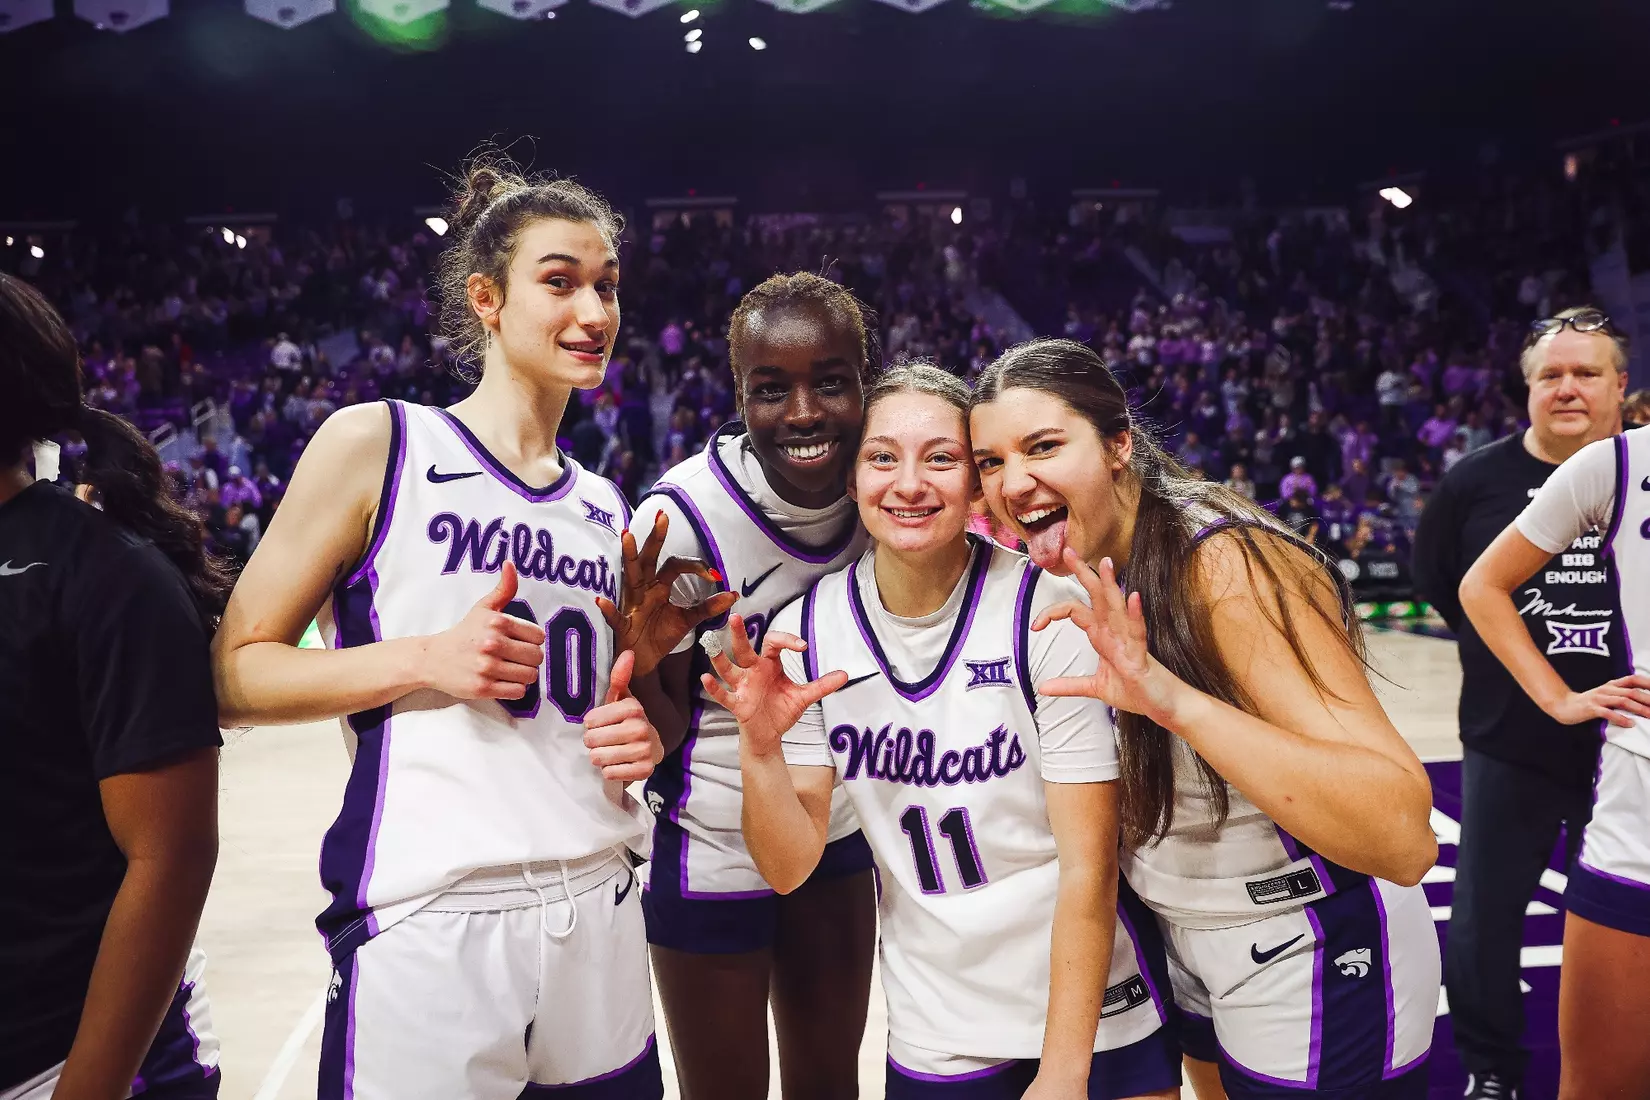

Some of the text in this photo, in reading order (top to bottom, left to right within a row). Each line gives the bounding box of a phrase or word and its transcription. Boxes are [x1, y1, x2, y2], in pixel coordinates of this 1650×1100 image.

[1561, 553, 1595, 567] BIG
[1545, 570, 1607, 585] ENOUGH
[1550, 624, 1606, 652] XII
[497, 598, 597, 724] 0
[965, 659, 1013, 688] XII
[829, 722, 1027, 789] Wildcats
[898, 804, 989, 895] 11
[1296, 879, 1309, 890] L
[1130, 984, 1143, 998] M
